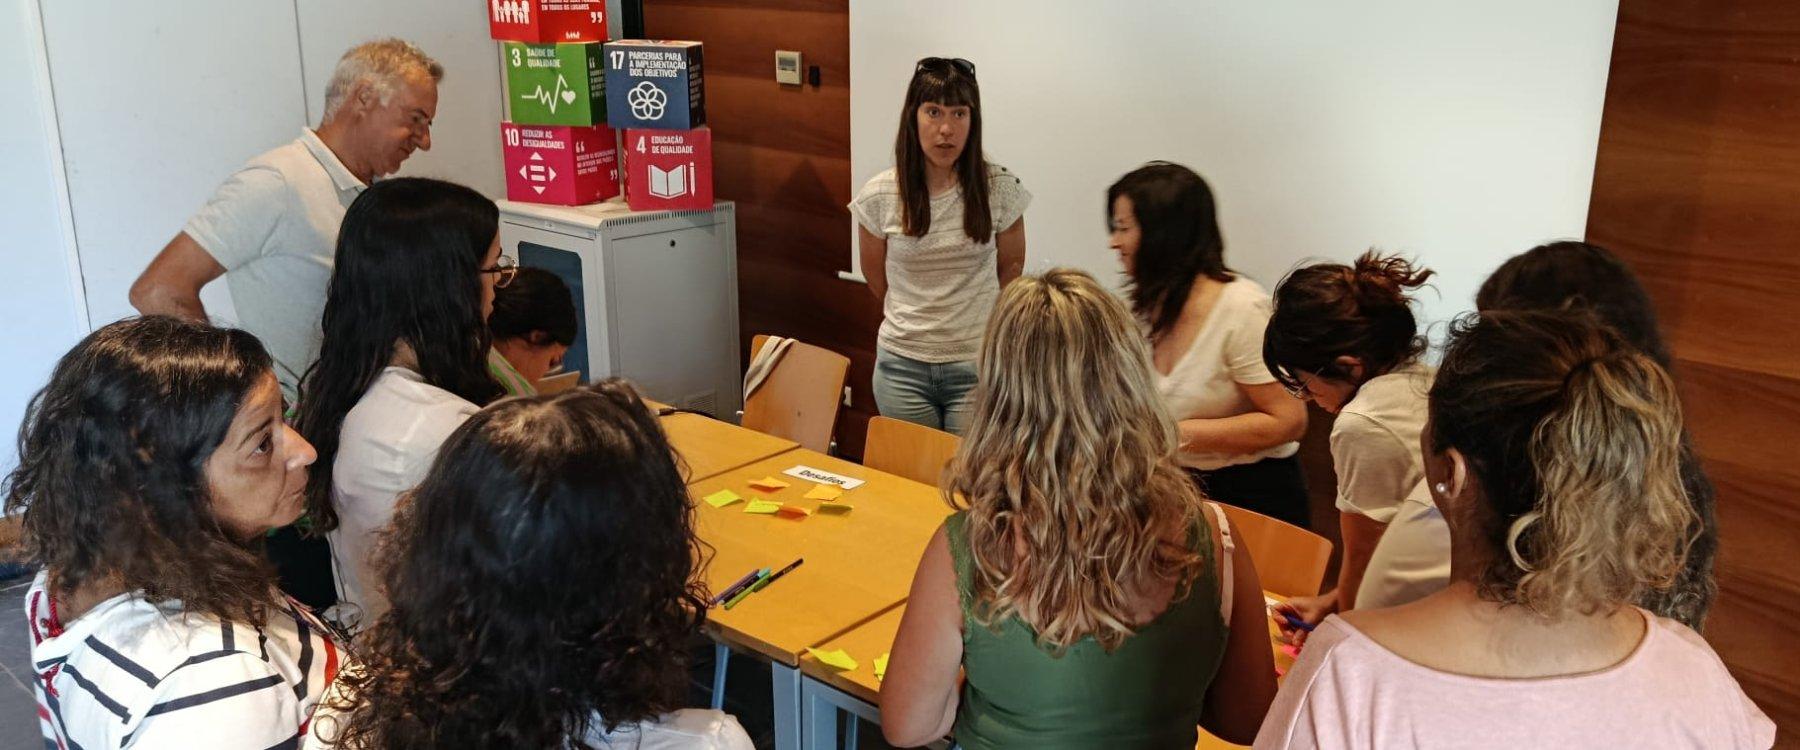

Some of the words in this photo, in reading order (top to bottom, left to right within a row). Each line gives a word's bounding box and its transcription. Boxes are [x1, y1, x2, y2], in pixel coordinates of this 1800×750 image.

[512, 48, 521, 67] 3
[547, 48, 555, 57] DE
[629, 51, 664, 60] PARCERIAS
[664, 52, 682, 61] PARA
[527, 58, 561, 68] QUALIDADE
[610, 51, 625, 70] 17
[629, 60, 634, 68] A
[635, 60, 686, 70] IMPLEMENTAÇÃO
[629, 68, 643, 76] DOS
[644, 69, 678, 78] OBJETIVOS
[505, 128, 519, 146] 10
[522, 129, 544, 138] REDUZIR
[545, 130, 553, 139] AS
[523, 139, 565, 149] DESIGUALDADES
[636, 136, 647, 154] 4
[651, 135, 684, 145] EDUCAÇÃO
[652, 146, 660, 154] DE
[660, 146, 693, 154] QUALIDADE
[799, 470, 847, 485] Desafios
